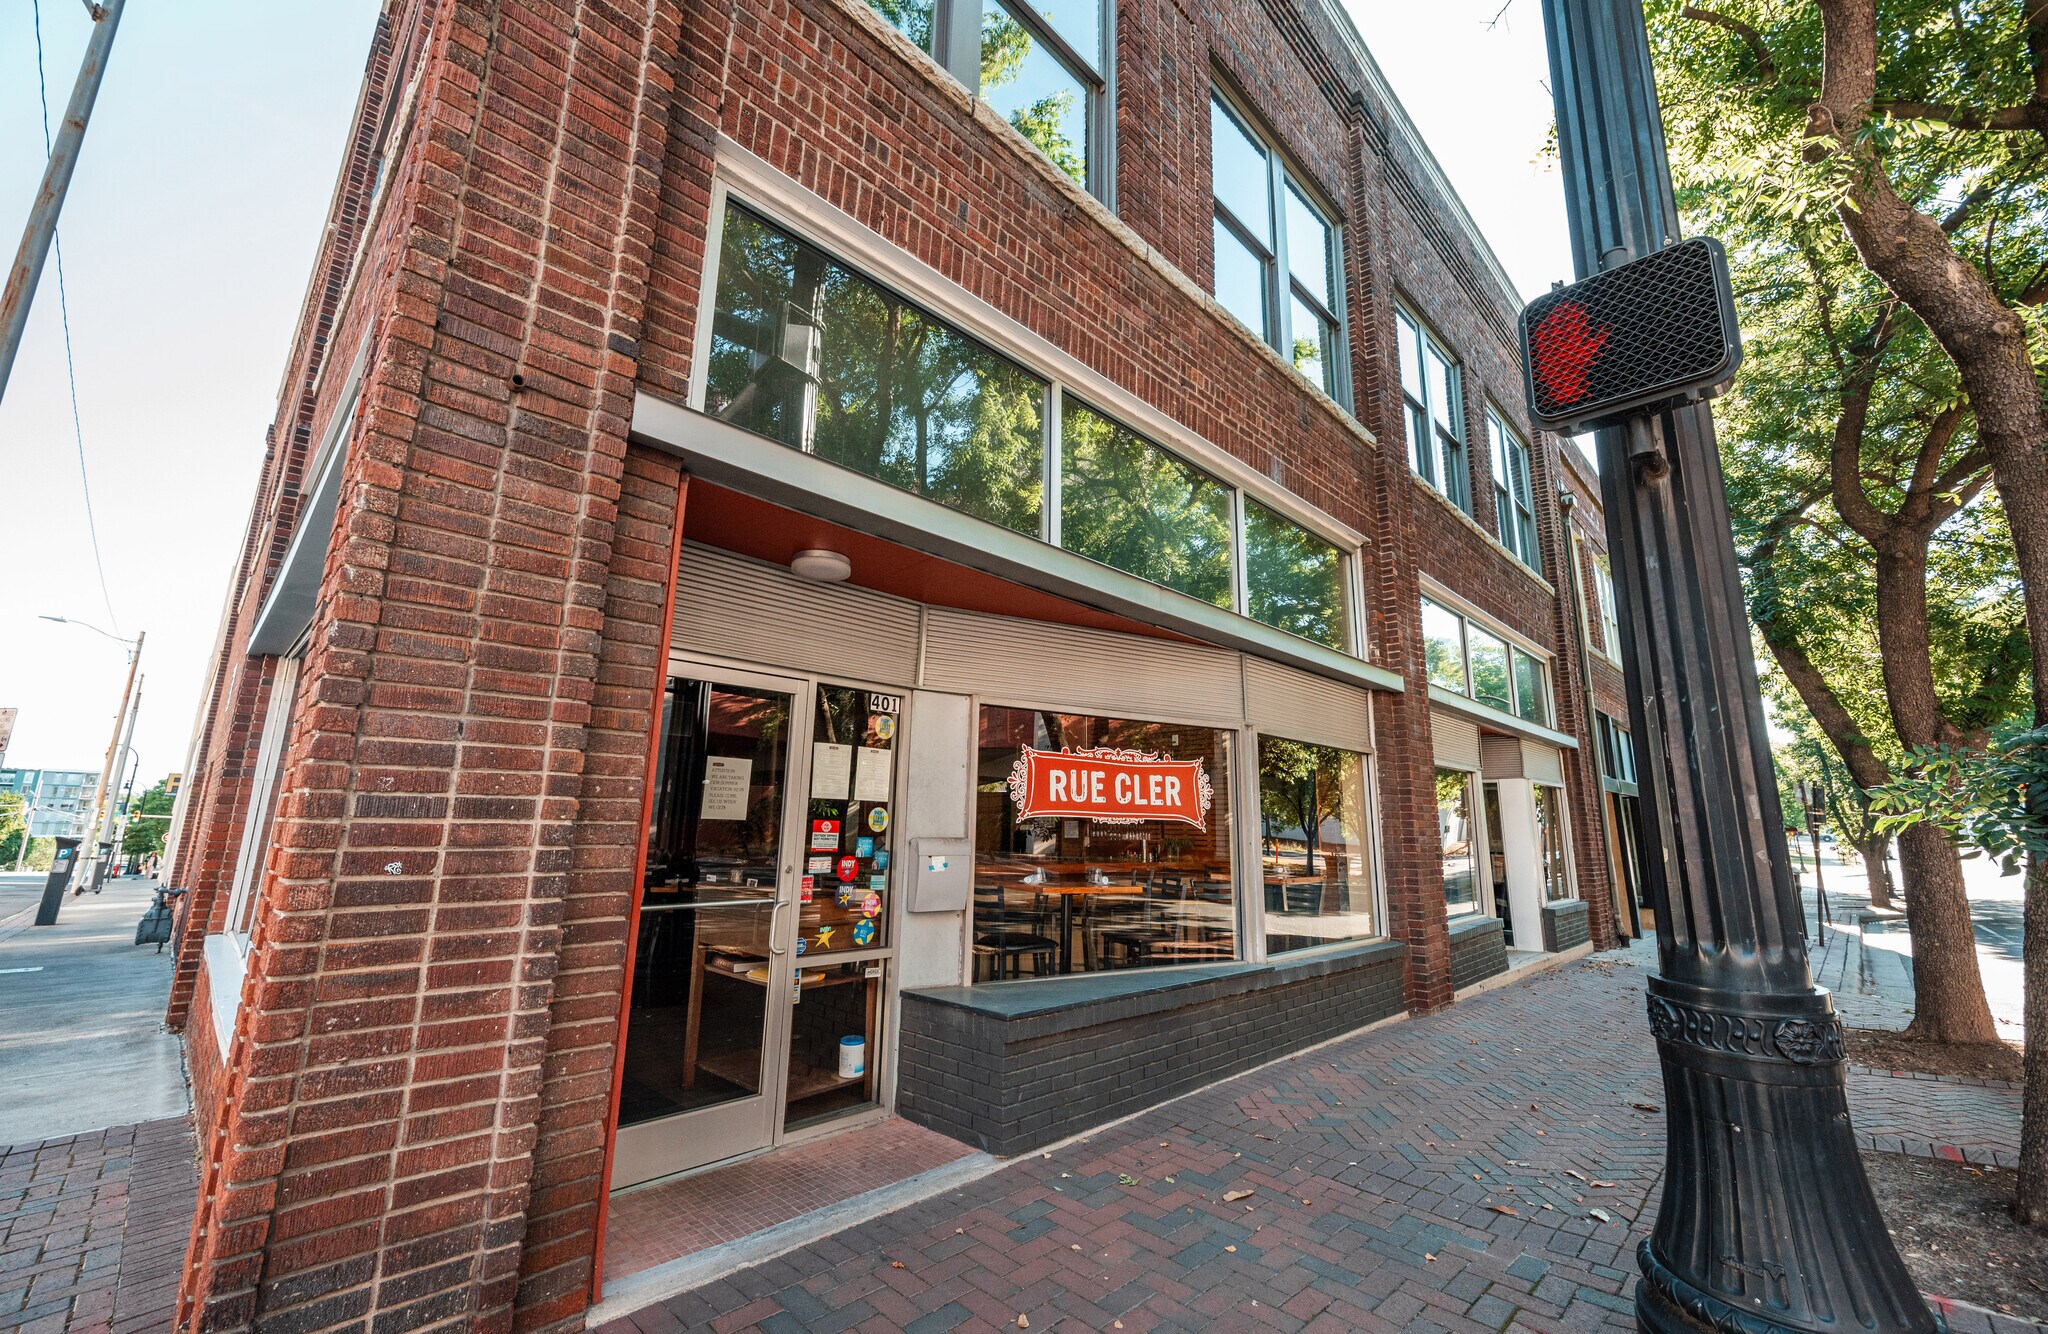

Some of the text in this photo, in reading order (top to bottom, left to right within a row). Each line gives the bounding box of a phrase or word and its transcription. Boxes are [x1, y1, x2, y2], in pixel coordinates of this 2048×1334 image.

[871, 695, 897, 713] 401
[1049, 769, 1182, 806] RUE CLER
[58, 849, 68, 858] P
[841, 859, 856, 868] INDY
[839, 885, 854, 894] INDY
